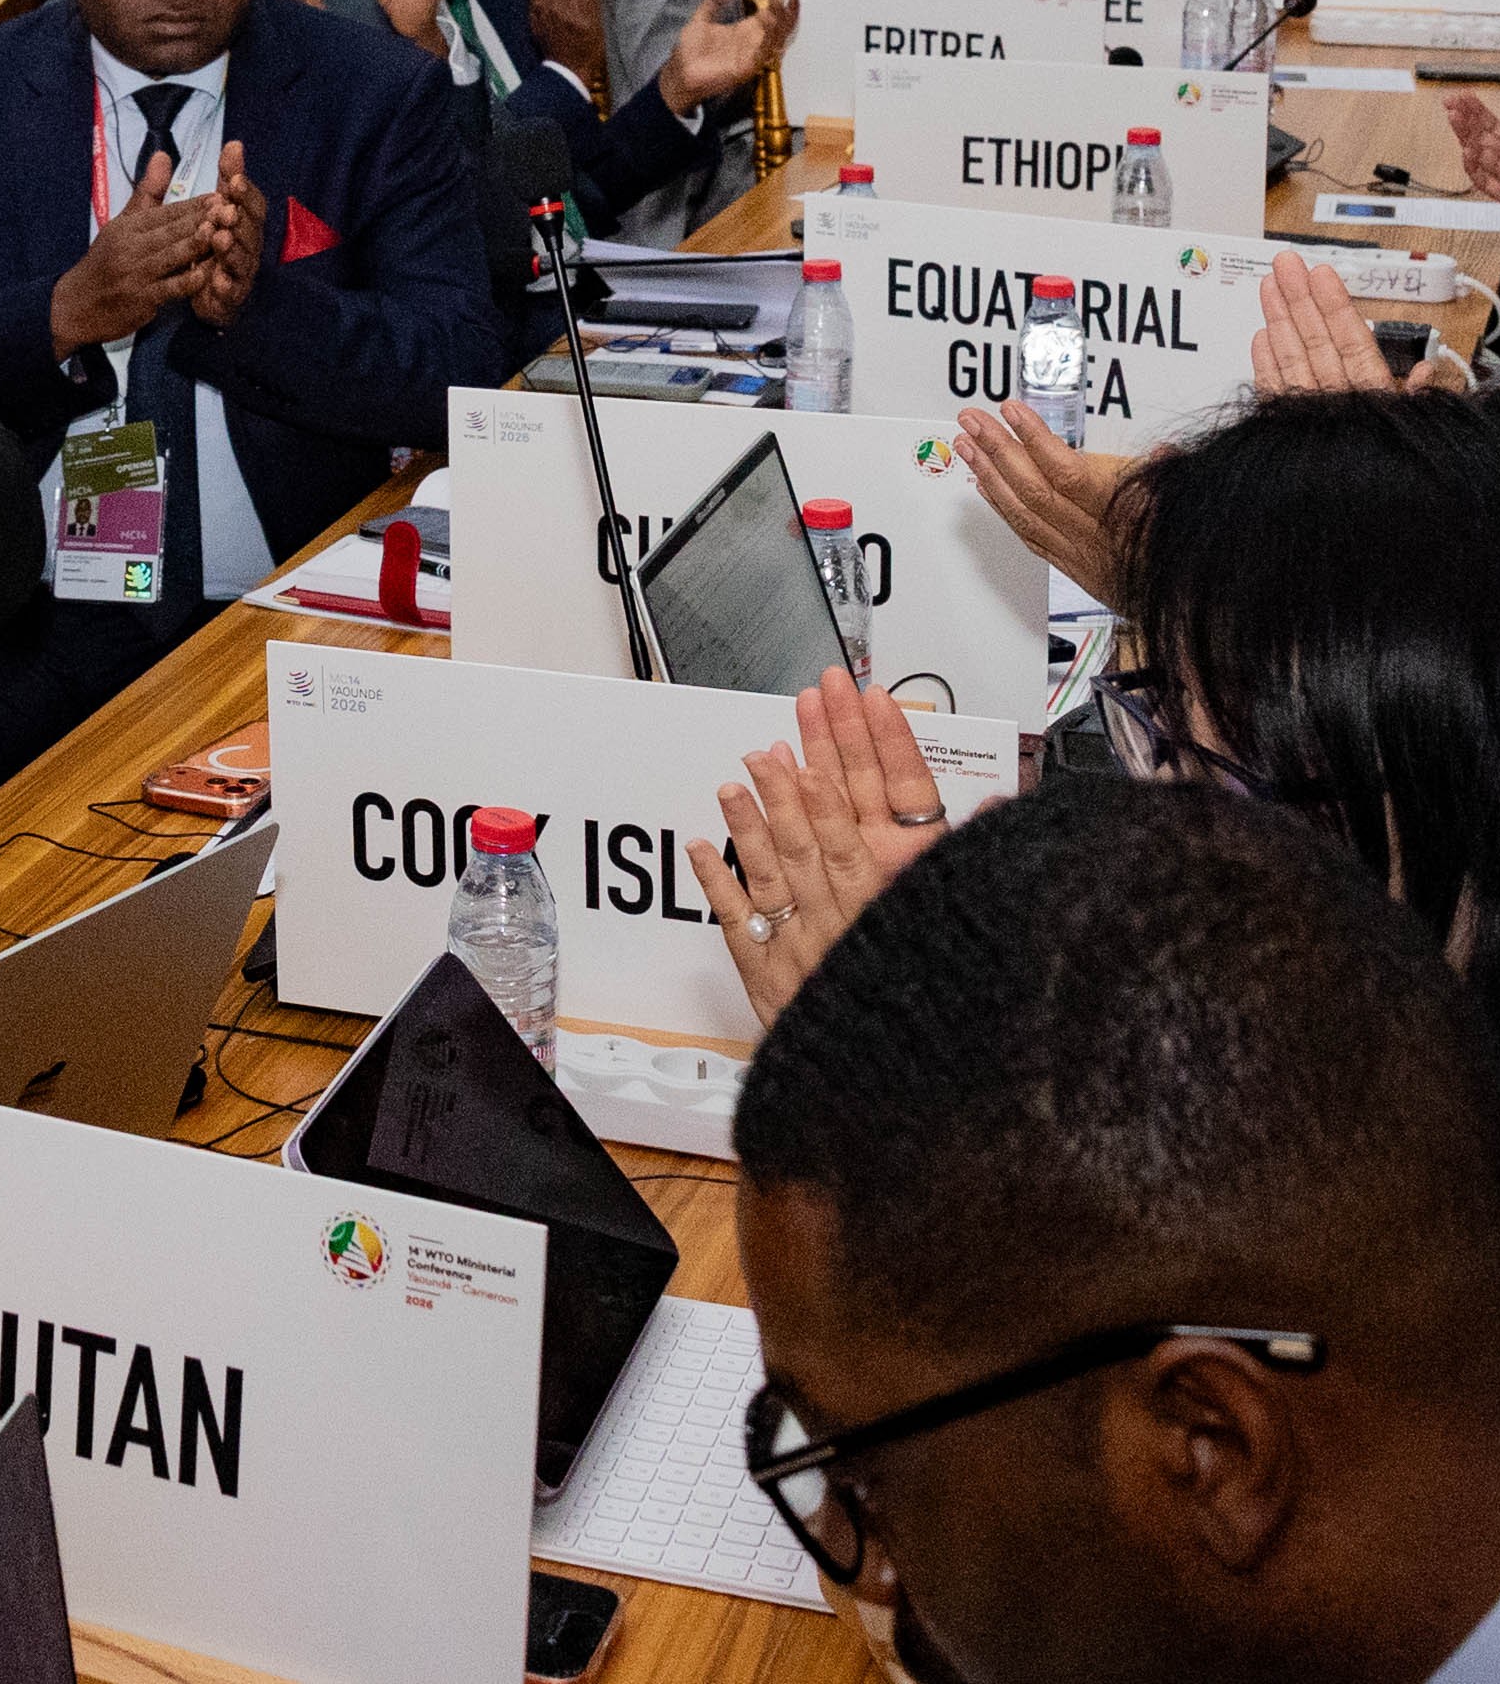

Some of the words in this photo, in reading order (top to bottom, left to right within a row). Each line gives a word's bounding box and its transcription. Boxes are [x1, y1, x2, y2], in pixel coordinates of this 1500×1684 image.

[864, 24, 1006, 60] ERITREA
[962, 135, 1124, 192] ETHIOPI
[888, 257, 1199, 352] EQUATRIAL
[949, 339, 1133, 420] GUA
[329, 683, 385, 702] YAOUNDÉ
[330, 697, 367, 714] 2026
[923, 755, 963, 767] nference
[924, 744, 948, 755] WTO
[949, 747, 997, 761] Ministerial
[584, 818, 750, 926] ISLA
[407, 1257, 473, 1282] Conference
[424, 1247, 454, 1264] WTO
[456, 1253, 516, 1279] Ministerial
[405, 1294, 434, 1310] 2026
[407, 1271, 452, 1291] Yaoundé
[462, 1283, 519, 1307] Cameroon
